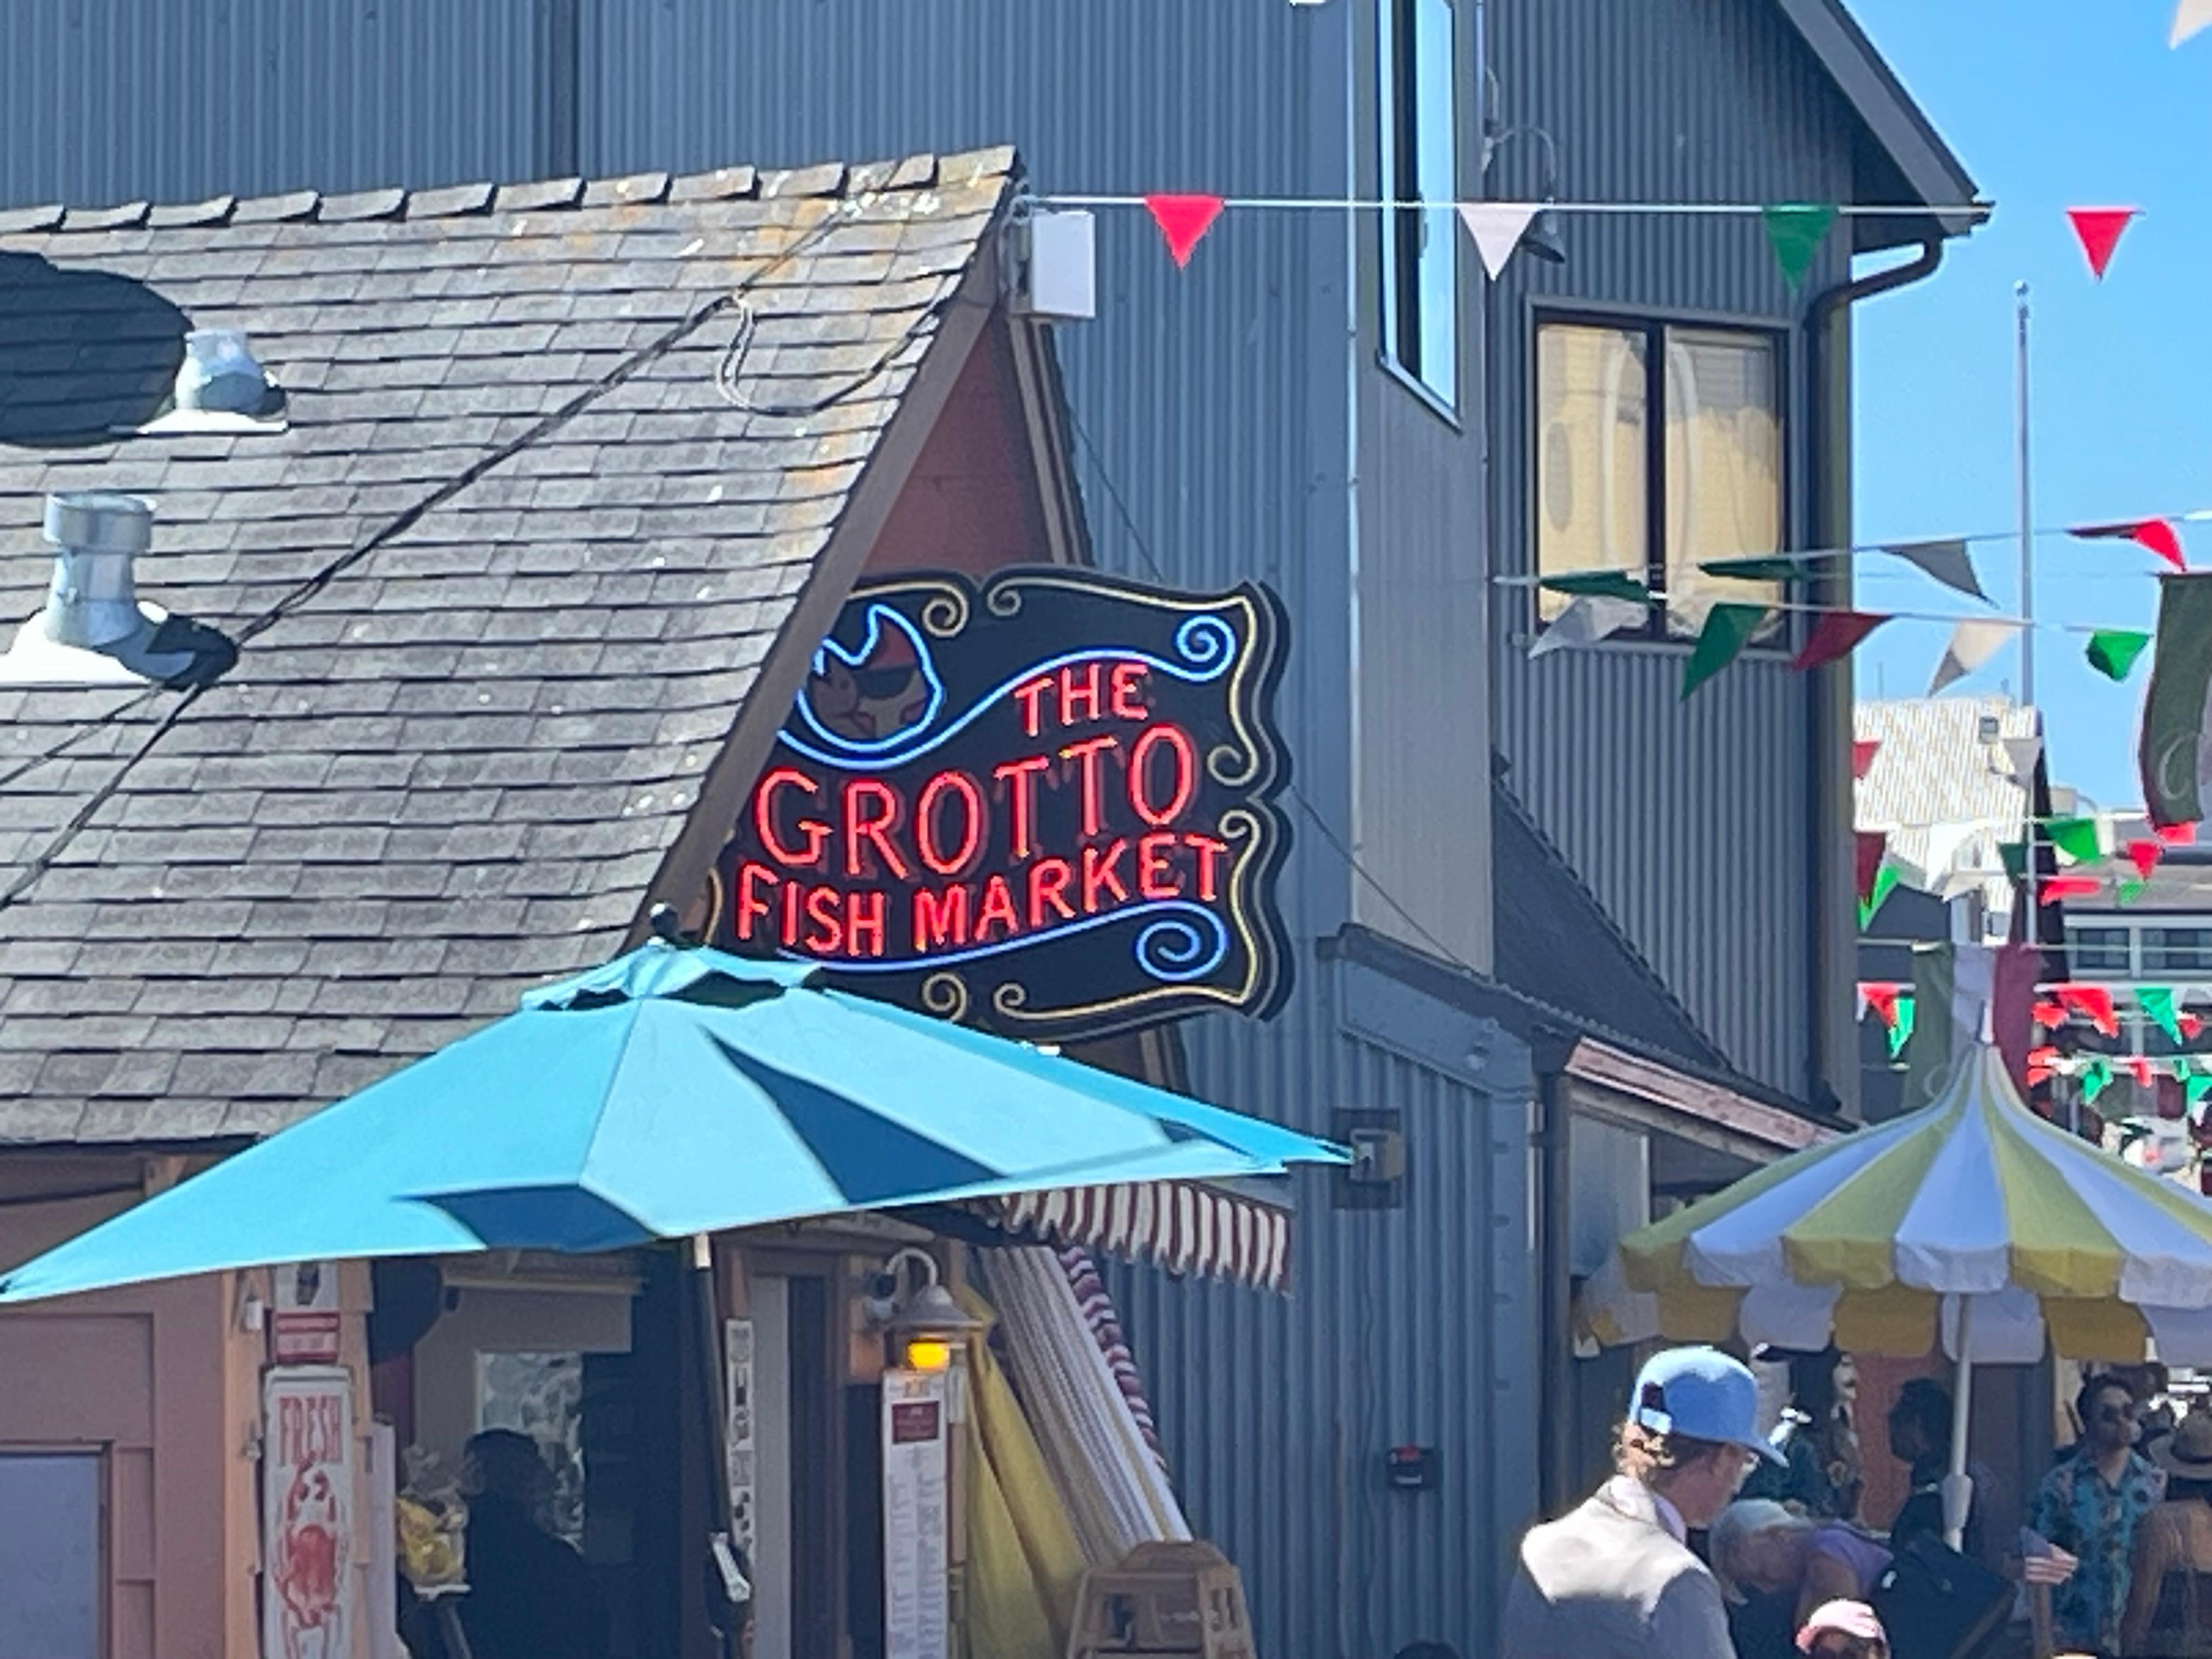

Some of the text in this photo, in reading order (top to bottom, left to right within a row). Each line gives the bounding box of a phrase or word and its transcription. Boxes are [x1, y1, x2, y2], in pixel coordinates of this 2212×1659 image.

[1015, 663, 1150, 736] THE
[753, 723, 1194, 880] GROTTO
[737, 832, 1229, 956] FISH MARKET
